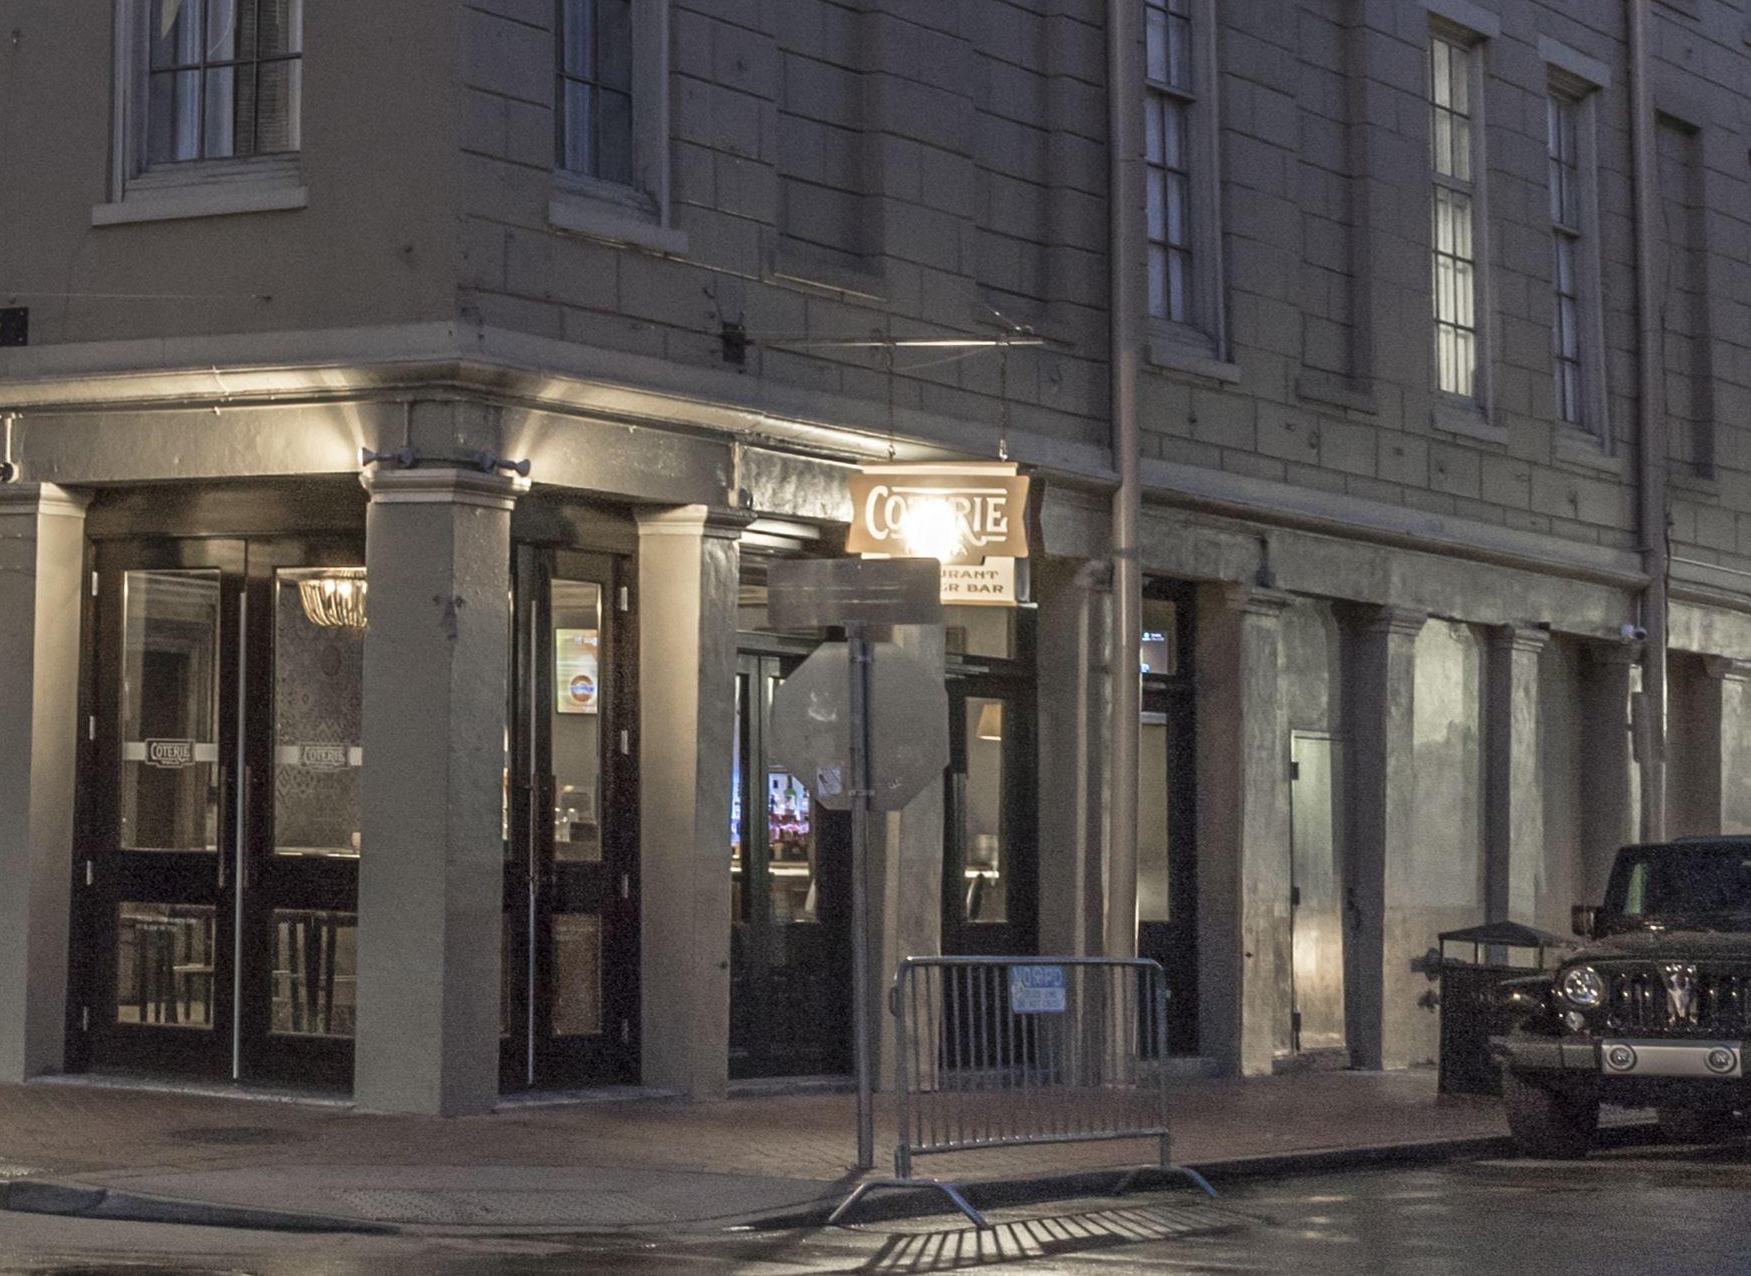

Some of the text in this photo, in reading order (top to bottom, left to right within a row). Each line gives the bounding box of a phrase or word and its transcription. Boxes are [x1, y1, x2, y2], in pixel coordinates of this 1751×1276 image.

[865, 485, 1008, 546] CORIE
[967, 584, 1004, 594] BAR
[151, 743, 190, 762] COTERIE
